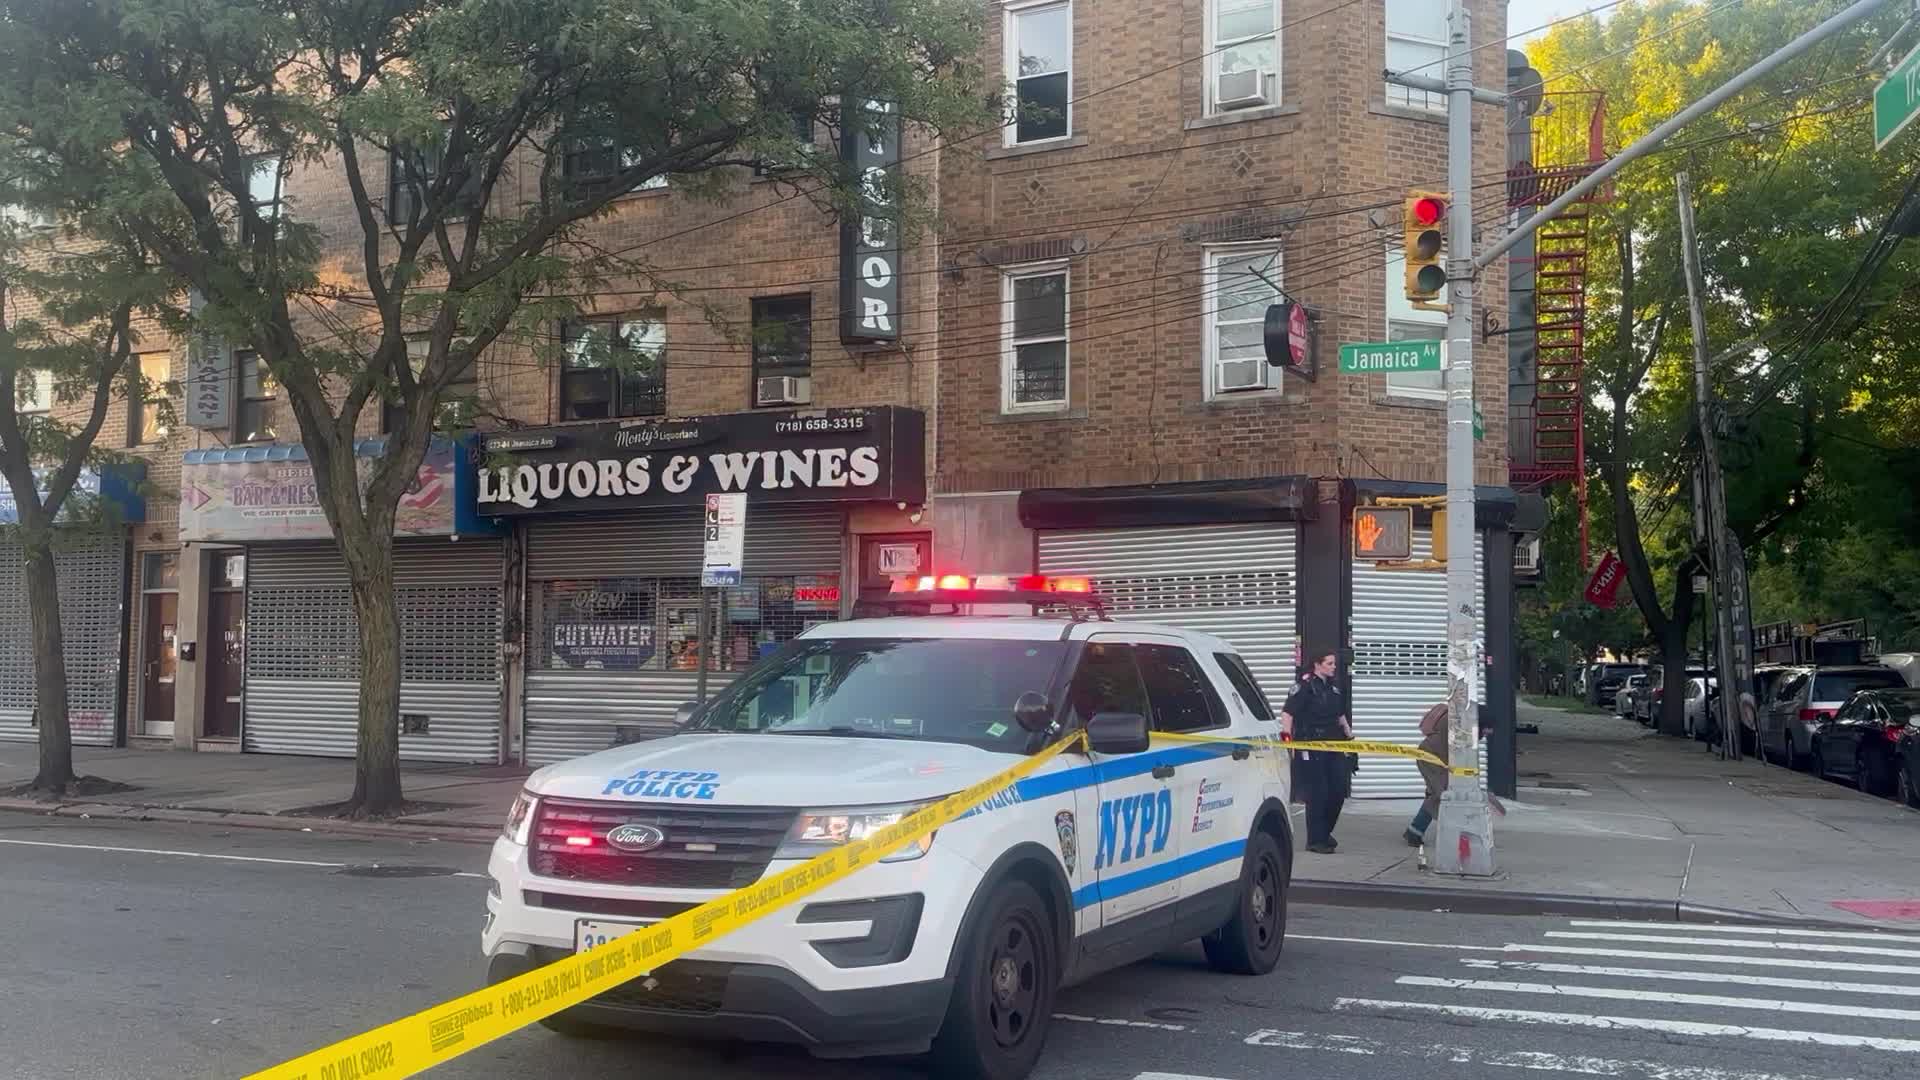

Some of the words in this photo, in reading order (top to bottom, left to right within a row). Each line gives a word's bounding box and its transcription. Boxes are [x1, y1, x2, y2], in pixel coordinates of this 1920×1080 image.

[1348, 346, 1418, 369] Jamaica
[775, 420, 802, 432] (718)
[806, 417, 864, 430] 658-3315
[512, 440, 540, 448] Jamaica
[541, 438, 553, 447] Ave
[615, 427, 659, 447] Monty's
[660, 431, 698, 441] Liquorland
[478, 456, 651, 508] LIQUORS
[662, 455, 699, 493] &
[709, 447, 879, 491] WINES
[233, 486, 264, 506] BAR
[709, 528, 717, 540] 2
[555, 624, 651, 646] CUTWATER
[628, 771, 719, 782] NYPD
[602, 779, 720, 800] POLICE
[616, 828, 648, 844] Ford
[1095, 788, 1171, 870] NYPD
